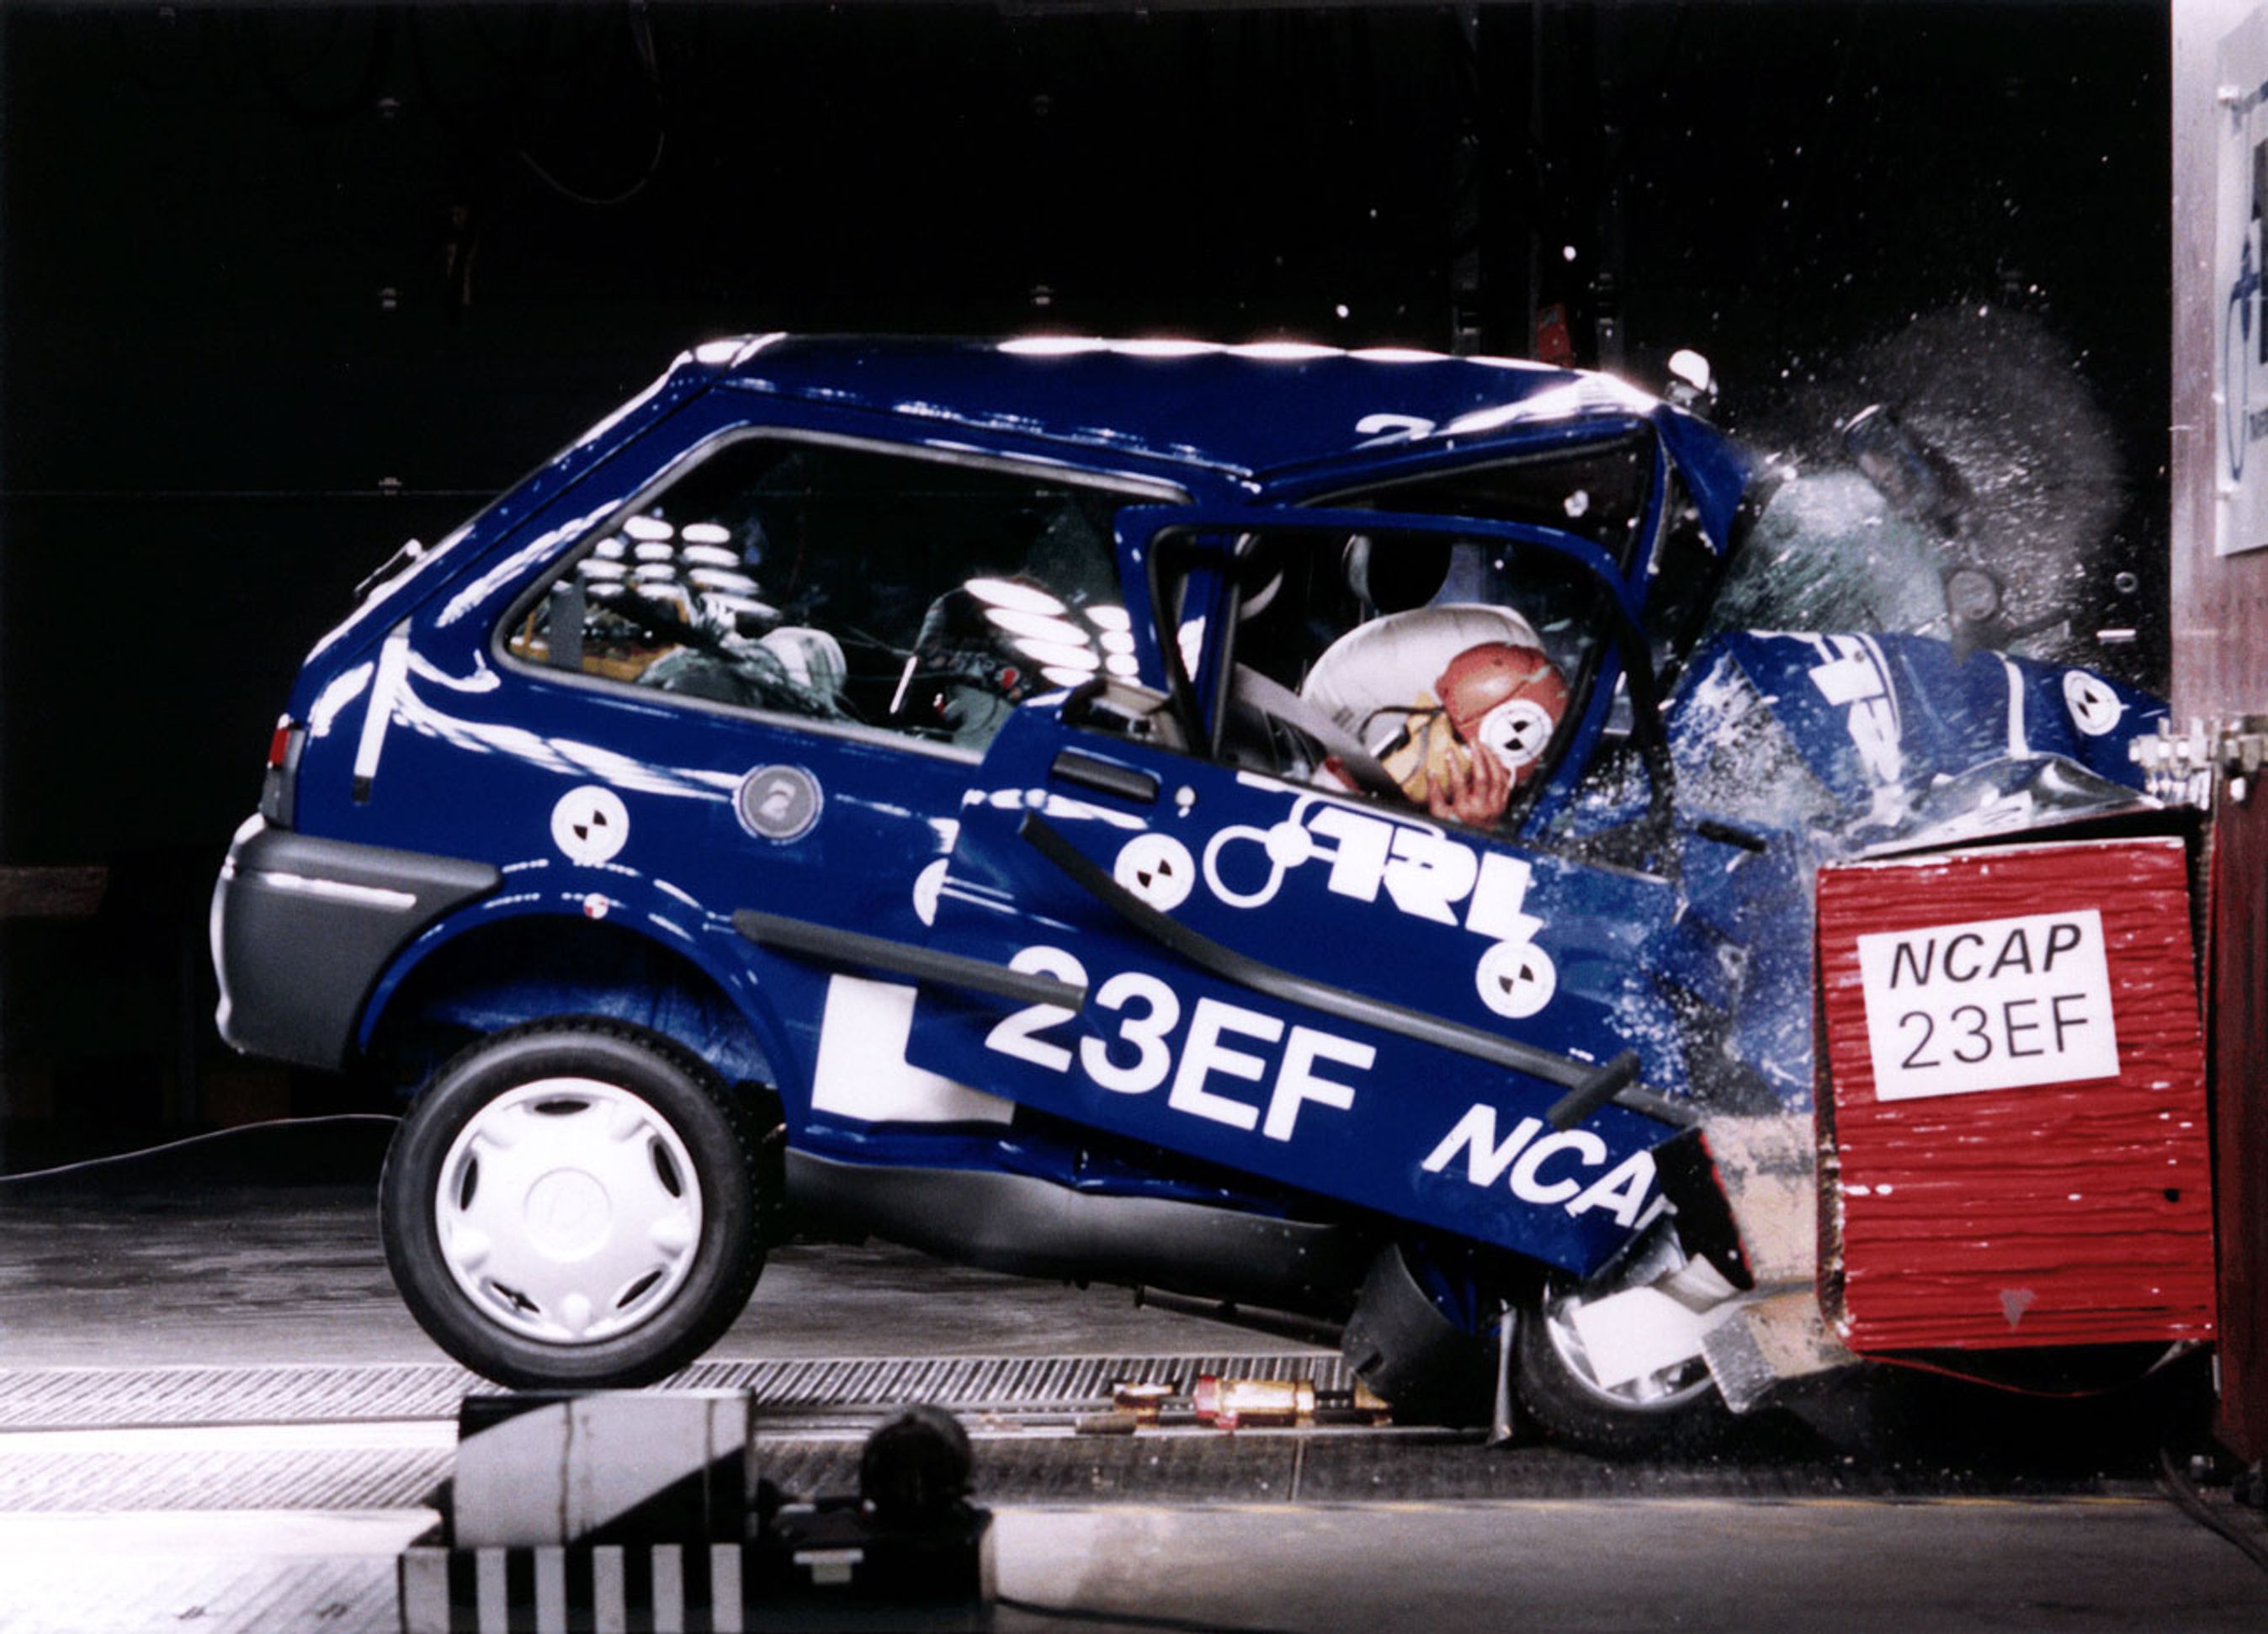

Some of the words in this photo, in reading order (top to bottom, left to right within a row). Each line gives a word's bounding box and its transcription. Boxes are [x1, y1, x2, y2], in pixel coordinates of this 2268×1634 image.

[1307, 805, 1545, 943] TRL
[1889, 923, 2081, 989] NCAP
[984, 946, 1378, 1143] 23EF
[1899, 993, 2089, 1069] 23EF
